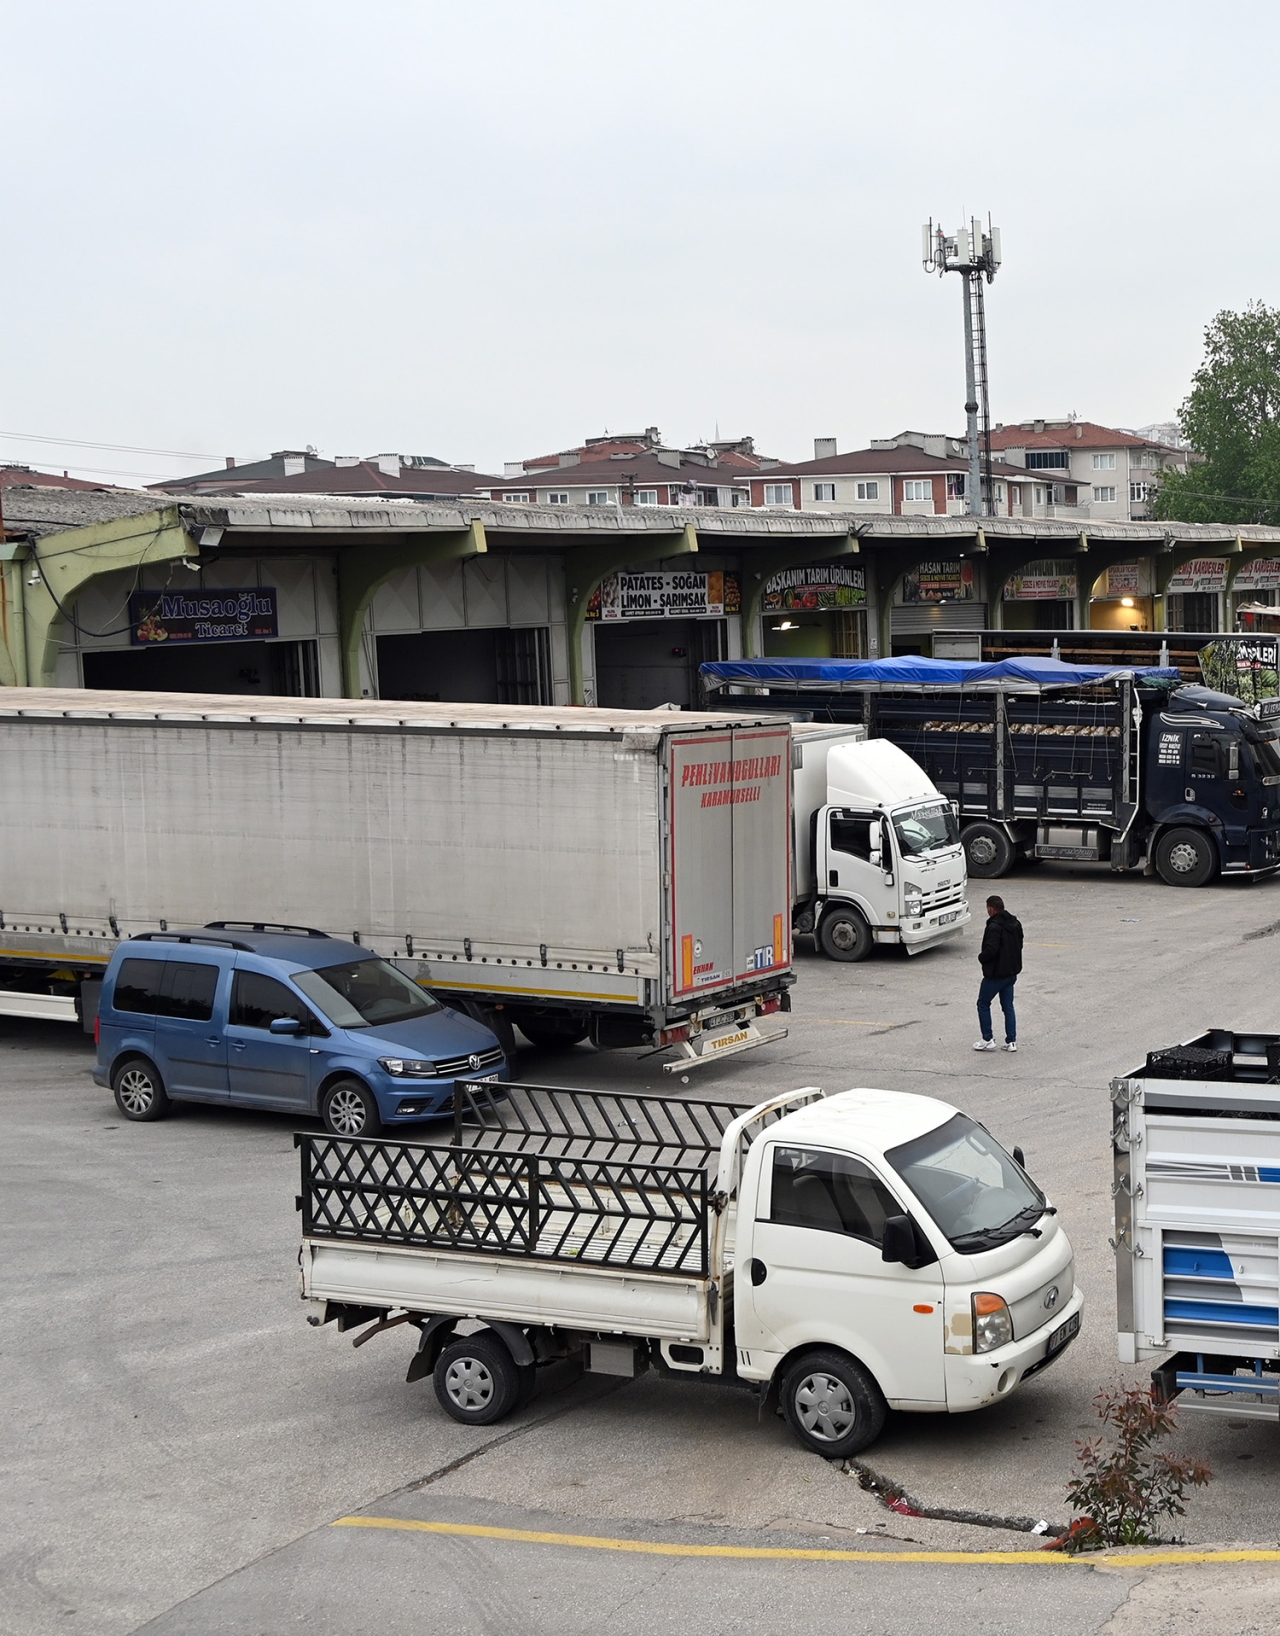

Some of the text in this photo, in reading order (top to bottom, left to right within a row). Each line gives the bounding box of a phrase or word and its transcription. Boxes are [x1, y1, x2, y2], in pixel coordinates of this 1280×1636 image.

[919, 562, 960, 574] HASAN TARIM
[1193, 561, 1225, 577] KARDEŞLER
[620, 576, 664, 591] PATATES
[672, 573, 706, 590] SOĞAN
[766, 565, 865, 594] BAŞKANIM TARIM ÜRÜNLERİ
[161, 593, 272, 623] Musaoğlu
[621, 591, 651, 609] LİMON
[659, 592, 706, 608] SARIMSAK
[195, 622, 248, 638] Ticaret
[1161, 733, 1180, 742] İZNİK
[755, 946, 773, 969] TIR
[701, 974, 720, 982] TIRSAN
[711, 1031, 748, 1049] TIRSAN
